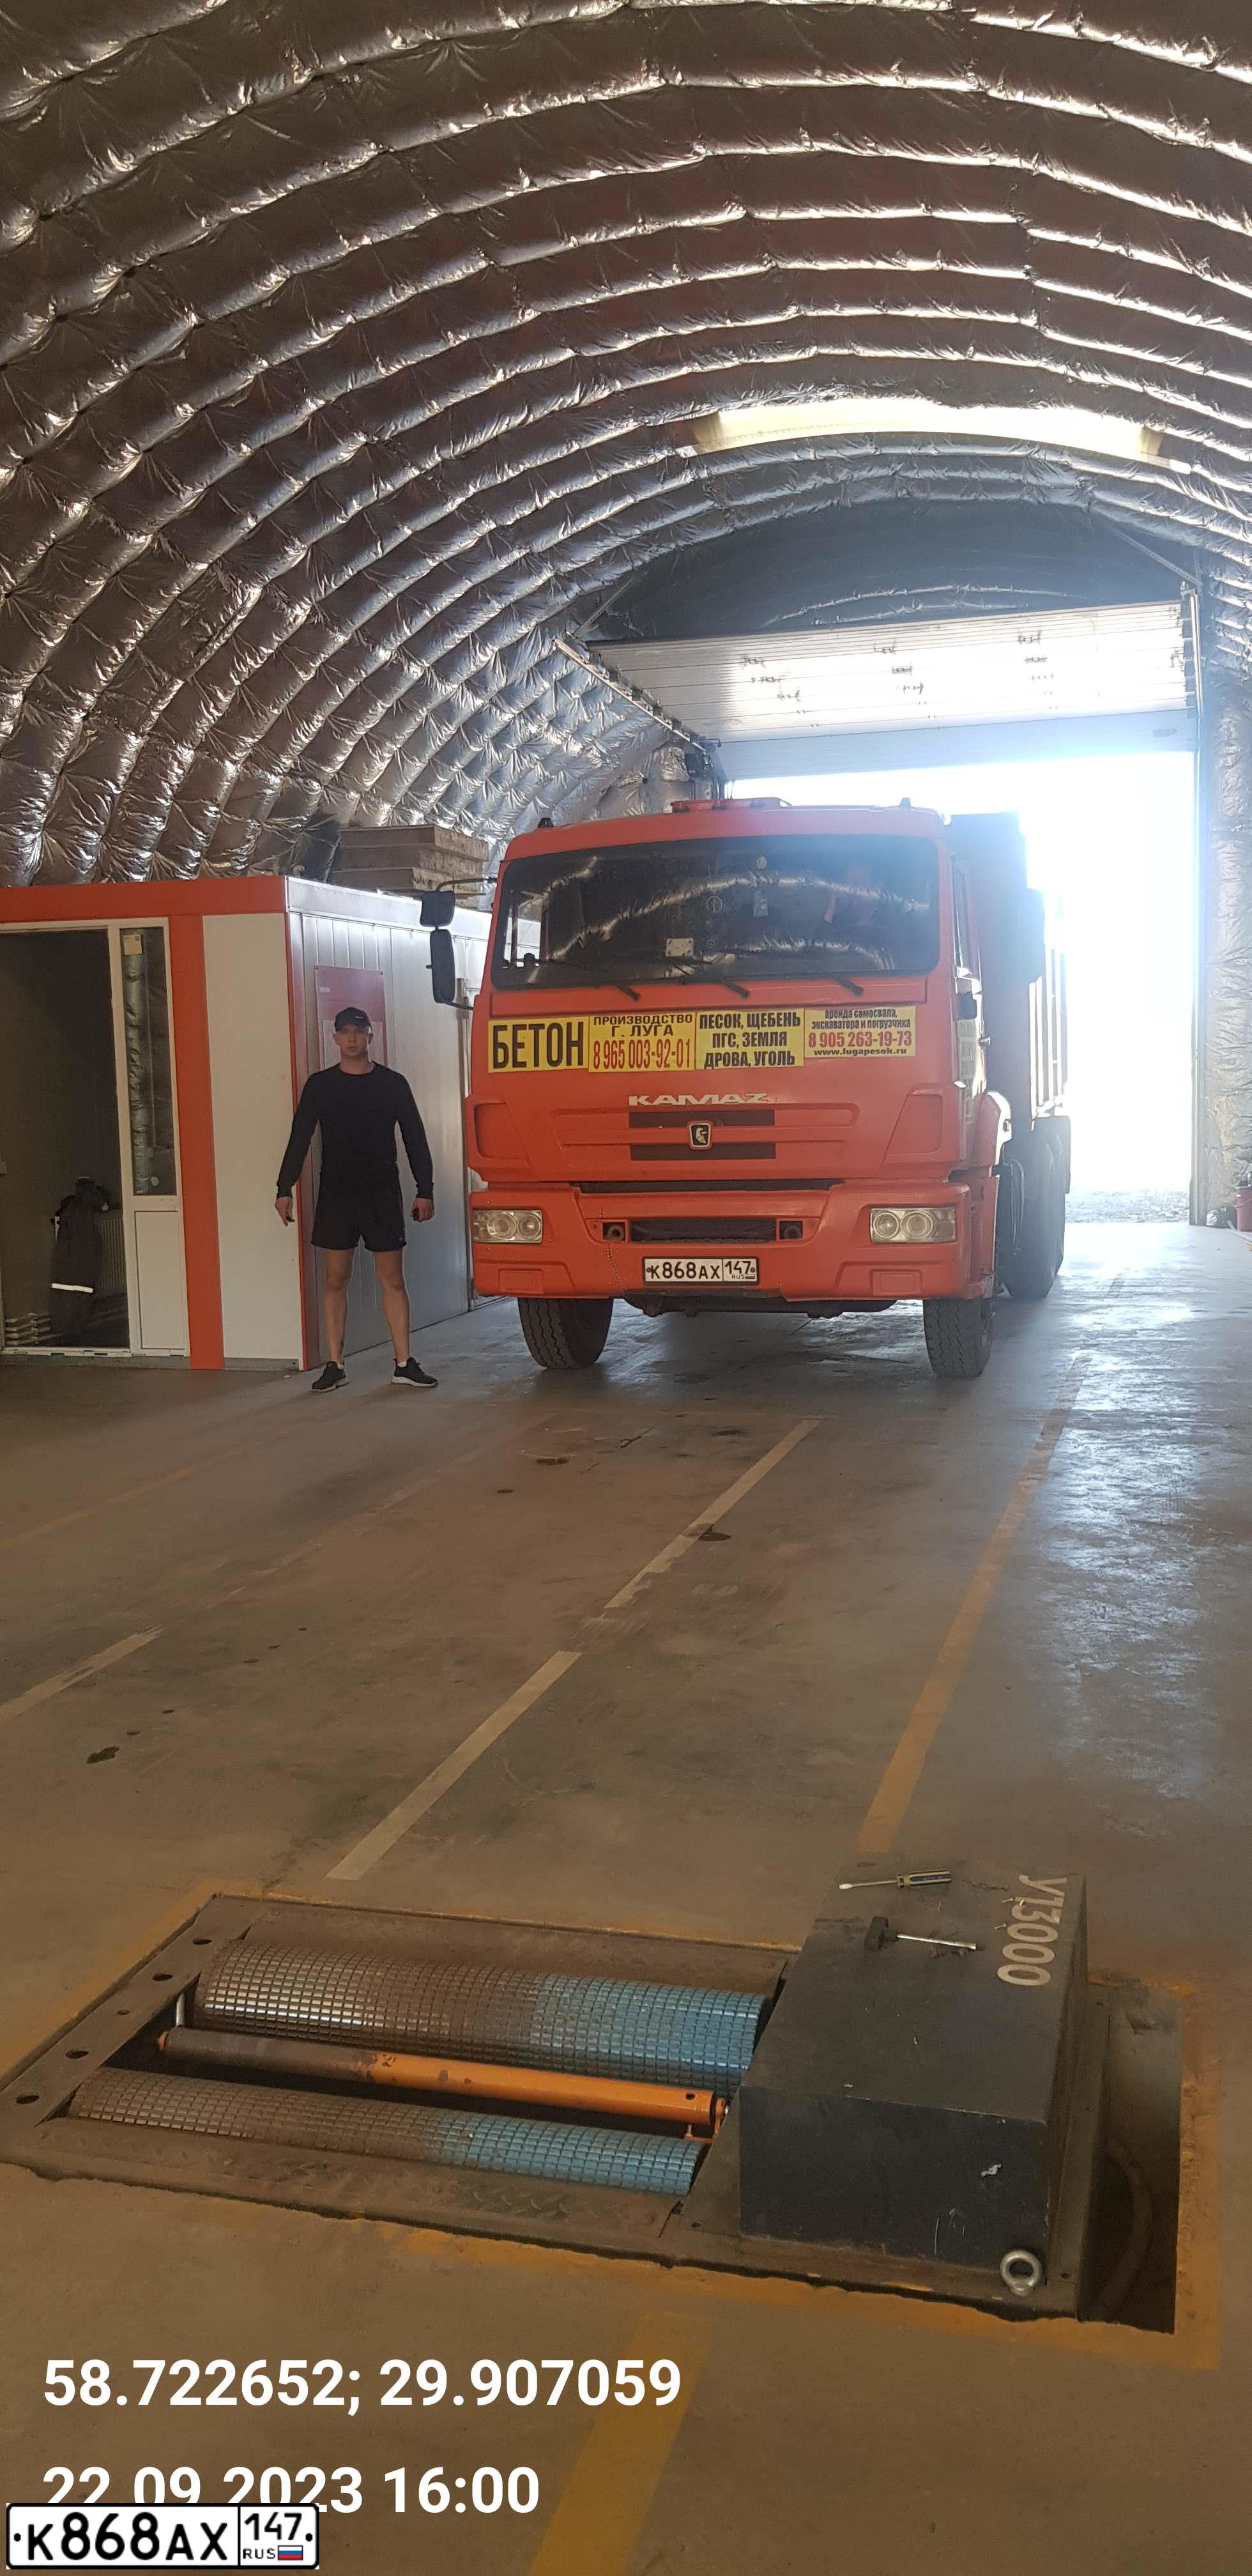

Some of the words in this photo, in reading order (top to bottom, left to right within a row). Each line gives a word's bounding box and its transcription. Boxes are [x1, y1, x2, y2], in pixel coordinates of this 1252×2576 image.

[593, 1014, 692, 1025] ПРОИЗВОДСТВО
[699, 1013, 744, 1030] ПЕСОК,
[747, 1011, 800, 1028] ЩЕБЕНЬ
[825, 1009, 853, 1020] аренда
[853, 1008, 897, 1018] самосвала,
[611, 1026, 625, 1037] Г.
[629, 1024, 674, 1036] ЛУГА
[811, 1020, 859, 1030] экскаватора
[860, 1020, 866, 1029] и
[867, 1018, 911, 1029] погрузчика
[492, 1022, 584, 1069] БЕТОН
[712, 1032, 739, 1049] ПГС,
[742, 1031, 787, 1047] ЗЕМЛЯ
[808, 1032, 816, 1048] 8
[820, 1032, 844, 1048] 905
[848, 1031, 912, 1047] 263-19-73
[593, 1040, 600, 1070] 8
[603, 1039, 625, 1070] 965
[629, 1038, 691, 1069] 003-92-01
[704, 1052, 751, 1069] ДРОВА,
[754, 1051, 795, 1066] УГОЛЬ
[814, 1048, 907, 1056] www.lugapesok.ru
[629, 1092, 770, 1106] KAMAZ
[650, 1261, 721, 1280] К868АХ
[724, 1261, 751, 1275] 147
